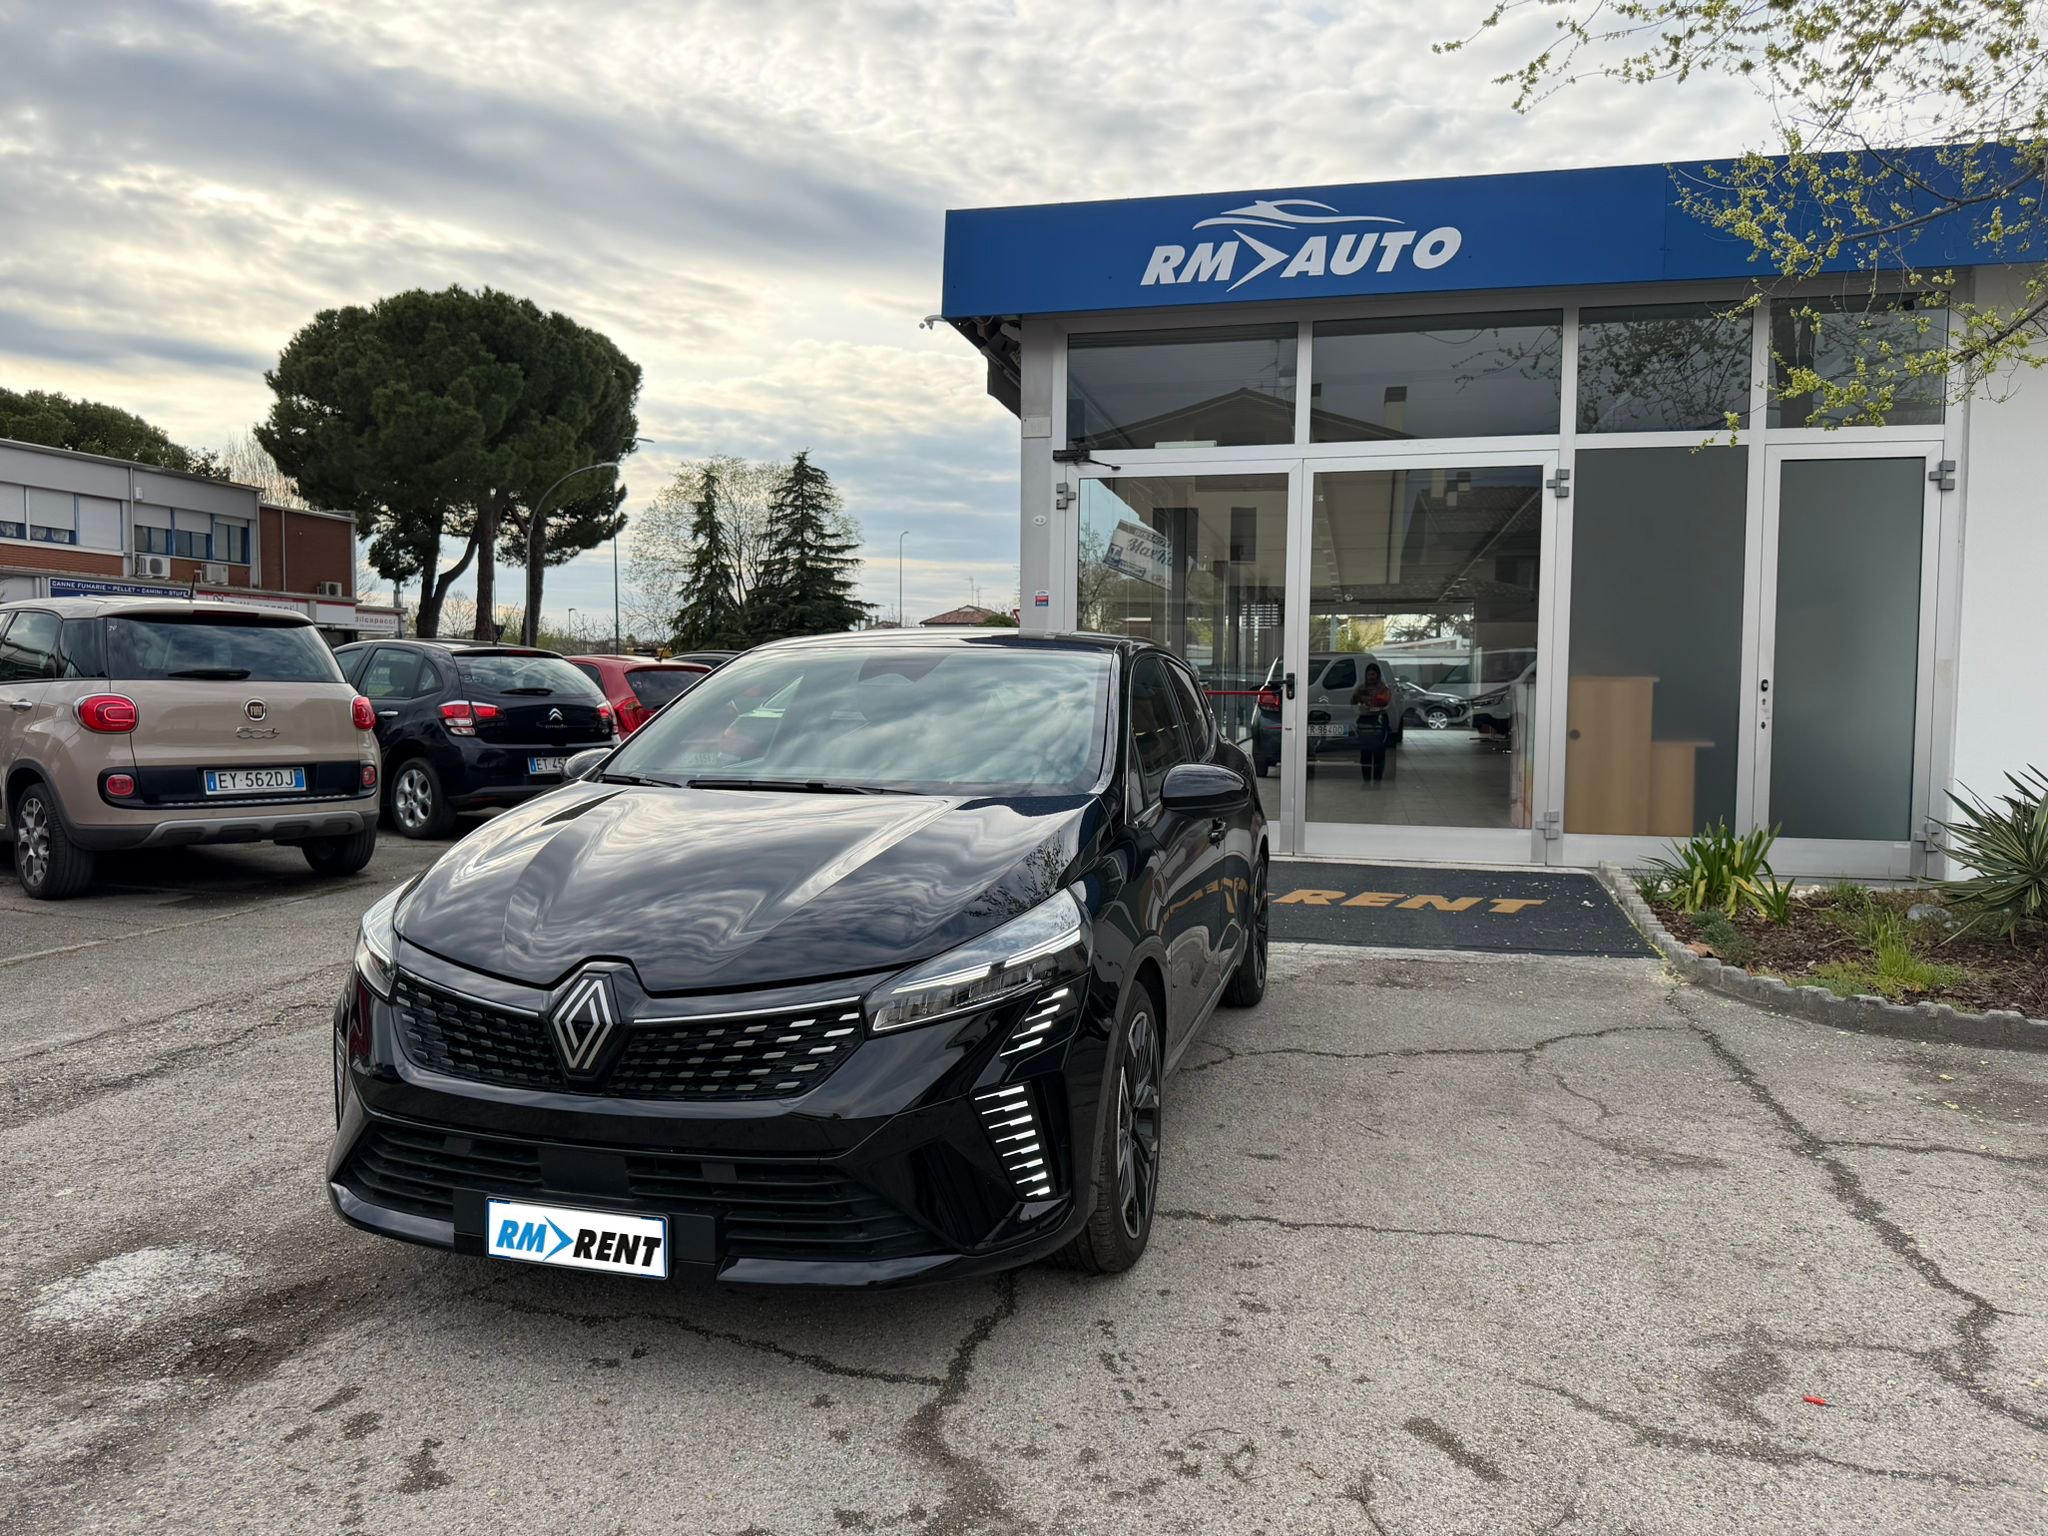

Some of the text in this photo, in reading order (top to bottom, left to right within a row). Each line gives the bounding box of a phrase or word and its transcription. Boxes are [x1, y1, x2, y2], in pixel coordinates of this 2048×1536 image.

[1140, 226, 1462, 286] RM AUTO
[52, 580, 75, 588] CANNE
[77, 582, 106, 590] FUMARIE
[112, 585, 135, 593] PELLET
[1271, 889, 1547, 914] RENT
[495, 1219, 662, 1267] RM RENT
